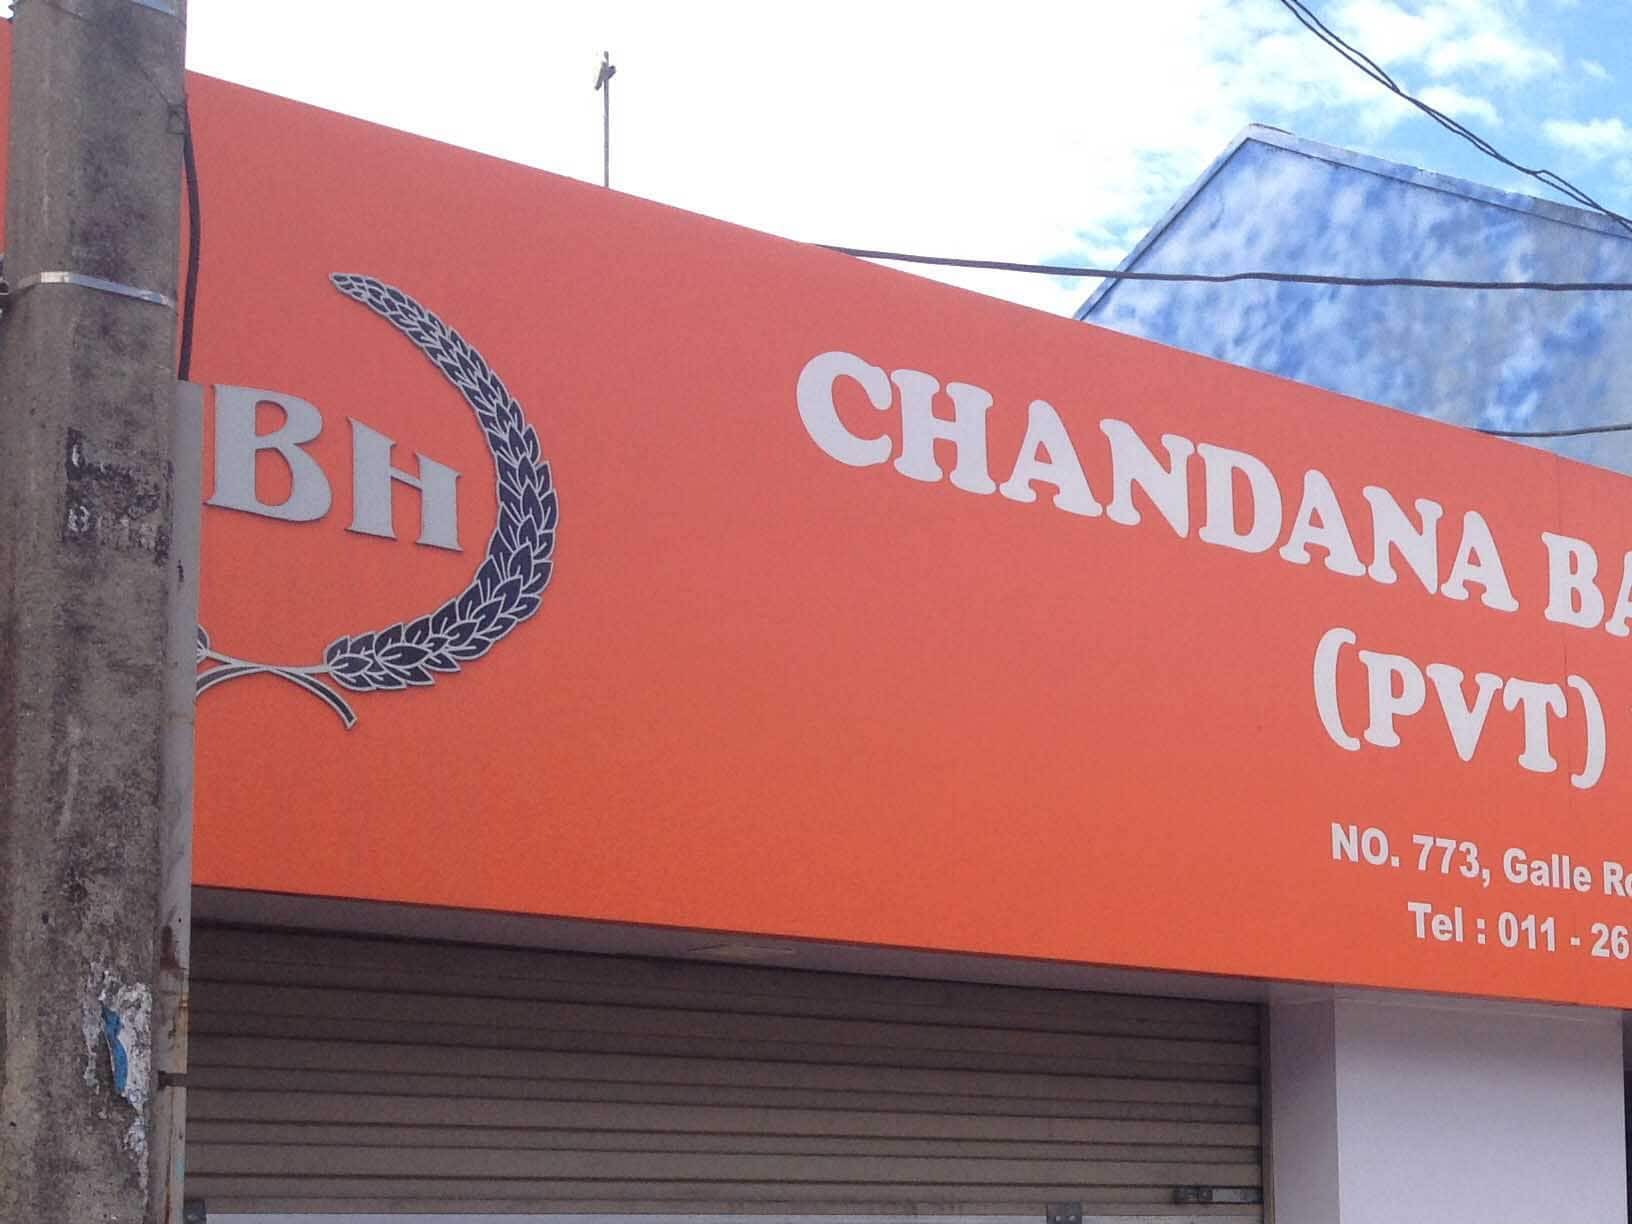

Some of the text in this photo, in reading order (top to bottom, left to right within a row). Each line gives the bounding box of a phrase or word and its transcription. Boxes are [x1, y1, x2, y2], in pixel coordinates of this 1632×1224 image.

[796, 350, 1521, 613] CHANDANA
[1313, 627, 1607, 790] (PVT)
[1331, 823, 1400, 868] NO.
[1413, 834, 1490, 887] 773,
[1503, 847, 1592, 893] Galle
[1498, 911, 1556, 951] 011
